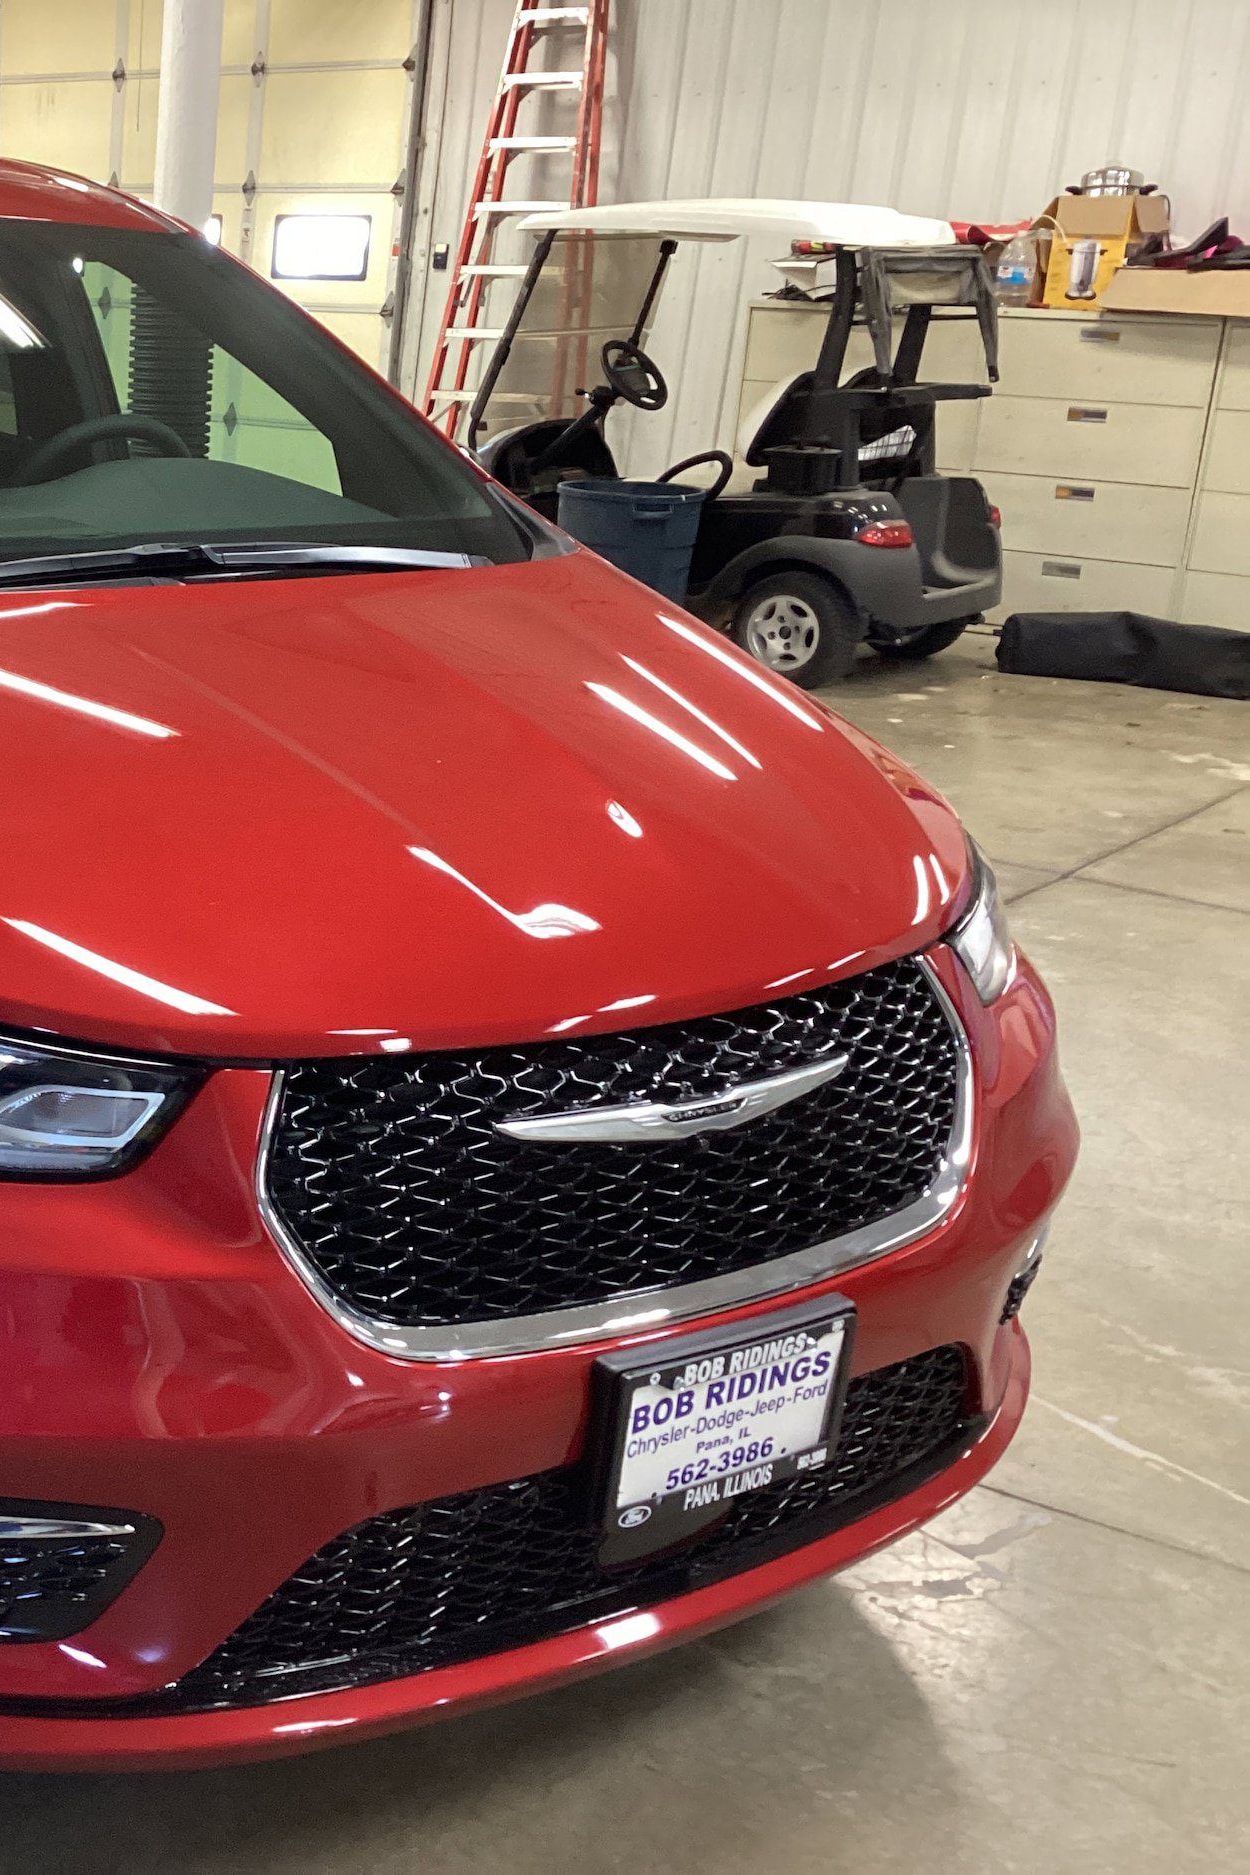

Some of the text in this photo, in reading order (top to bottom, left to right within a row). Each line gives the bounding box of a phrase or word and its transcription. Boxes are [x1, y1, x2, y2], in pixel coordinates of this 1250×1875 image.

[684, 1332, 807, 1386] BOB RIDINGS
[627, 1380, 828, 1459] Chrysler-Dodge-Jeep-Ford
[632, 1351, 831, 1434] BOB RIDINGS
[666, 1436, 775, 1491] 562-3986
[696, 1427, 751, 1454] Pana, IL
[723, 1463, 774, 1499] ILLINOIS
